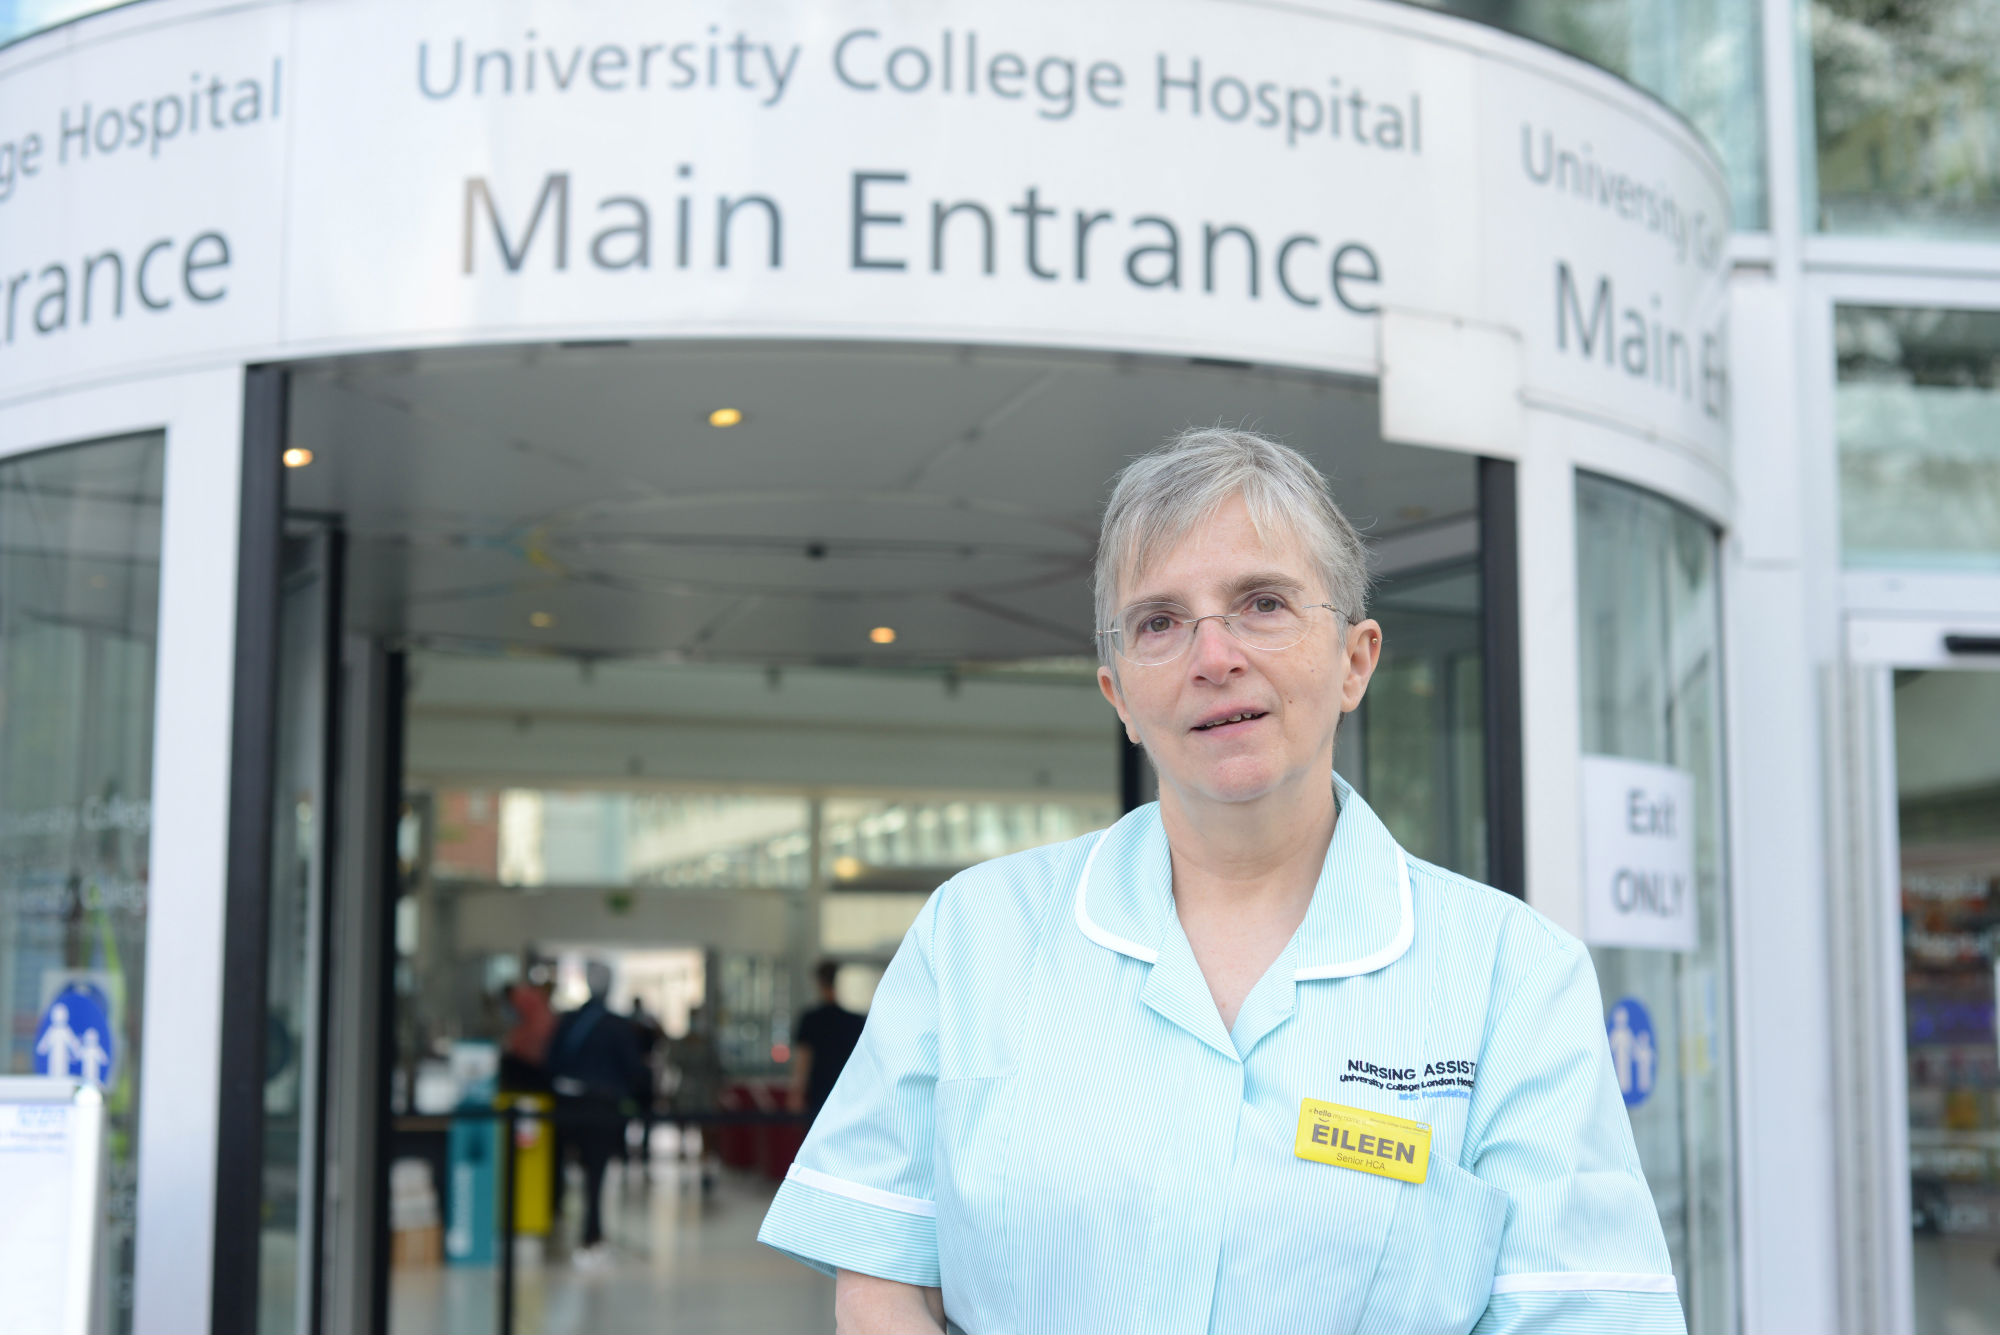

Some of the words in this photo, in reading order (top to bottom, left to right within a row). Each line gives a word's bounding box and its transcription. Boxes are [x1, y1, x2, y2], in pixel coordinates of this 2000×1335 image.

[58, 56, 283, 166] Hospital
[417, 25, 801, 107] University
[833, 28, 1125, 121] College
[1156, 53, 1422, 155] Hospital
[1521, 122, 1687, 266] University
[460, 163, 784, 275] Main
[849, 169, 1383, 316] Entrance
[0, 229, 233, 345] rance
[1555, 258, 1692, 401] Main
[1626, 786, 1678, 841] Exit
[1611, 867, 1687, 919] ONLY
[1339, 1073, 1384, 1090] University
[1385, 1082, 1420, 1092] College
[1421, 1077, 1455, 1088] London
[1347, 1058, 1416, 1081] NURSING
[1311, 1122, 1416, 1165] EILEEN
[1336, 1152, 1364, 1167] Senior
[1365, 1158, 1386, 1171] HCA
